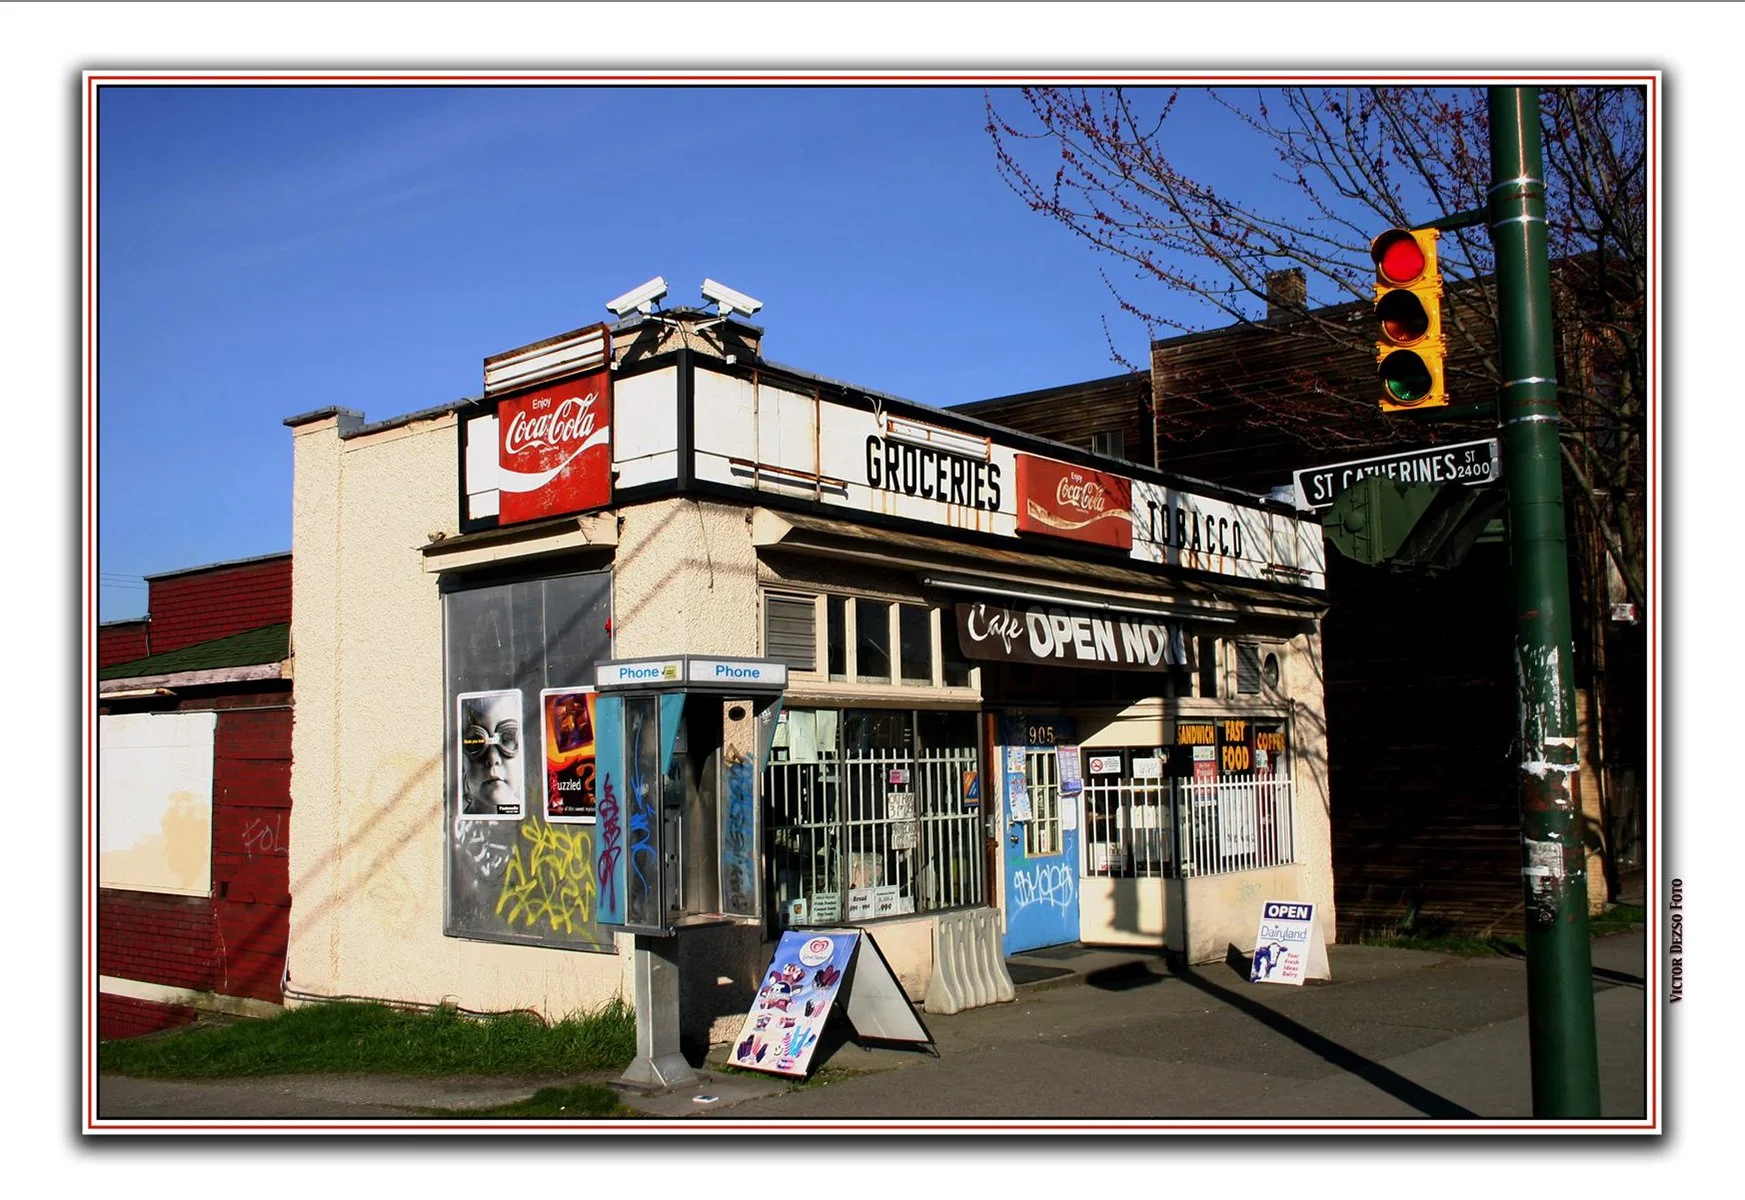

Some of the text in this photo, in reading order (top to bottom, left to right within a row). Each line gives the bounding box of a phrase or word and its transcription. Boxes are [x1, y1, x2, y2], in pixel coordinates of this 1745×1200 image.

[532, 398, 552, 410] Enjoy
[505, 391, 600, 455] Coca-Cola
[1464, 450, 1476, 463] ST
[866, 435, 1001, 512] GROCERIES
[1457, 462, 1490, 478] 2400
[1056, 477, 1105, 511] Coca-Cola
[1313, 473, 1334, 500] ST
[1147, 500, 1242, 559] TOBACCO
[967, 604, 1023, 655] Cafe
[1025, 606, 1118, 662] OPEN
[619, 667, 659, 680] Phone
[715, 664, 761, 679] Phone
[1029, 726, 1055, 744] 905
[1177, 725, 1215, 745] SANDWICH
[1223, 720, 1247, 742] FAST
[1222, 746, 1249, 771] FOOD
[550, 778, 582, 791] uzzled
[1267, 904, 1309, 919] OPEN
[1260, 925, 1308, 941] Dairyland
